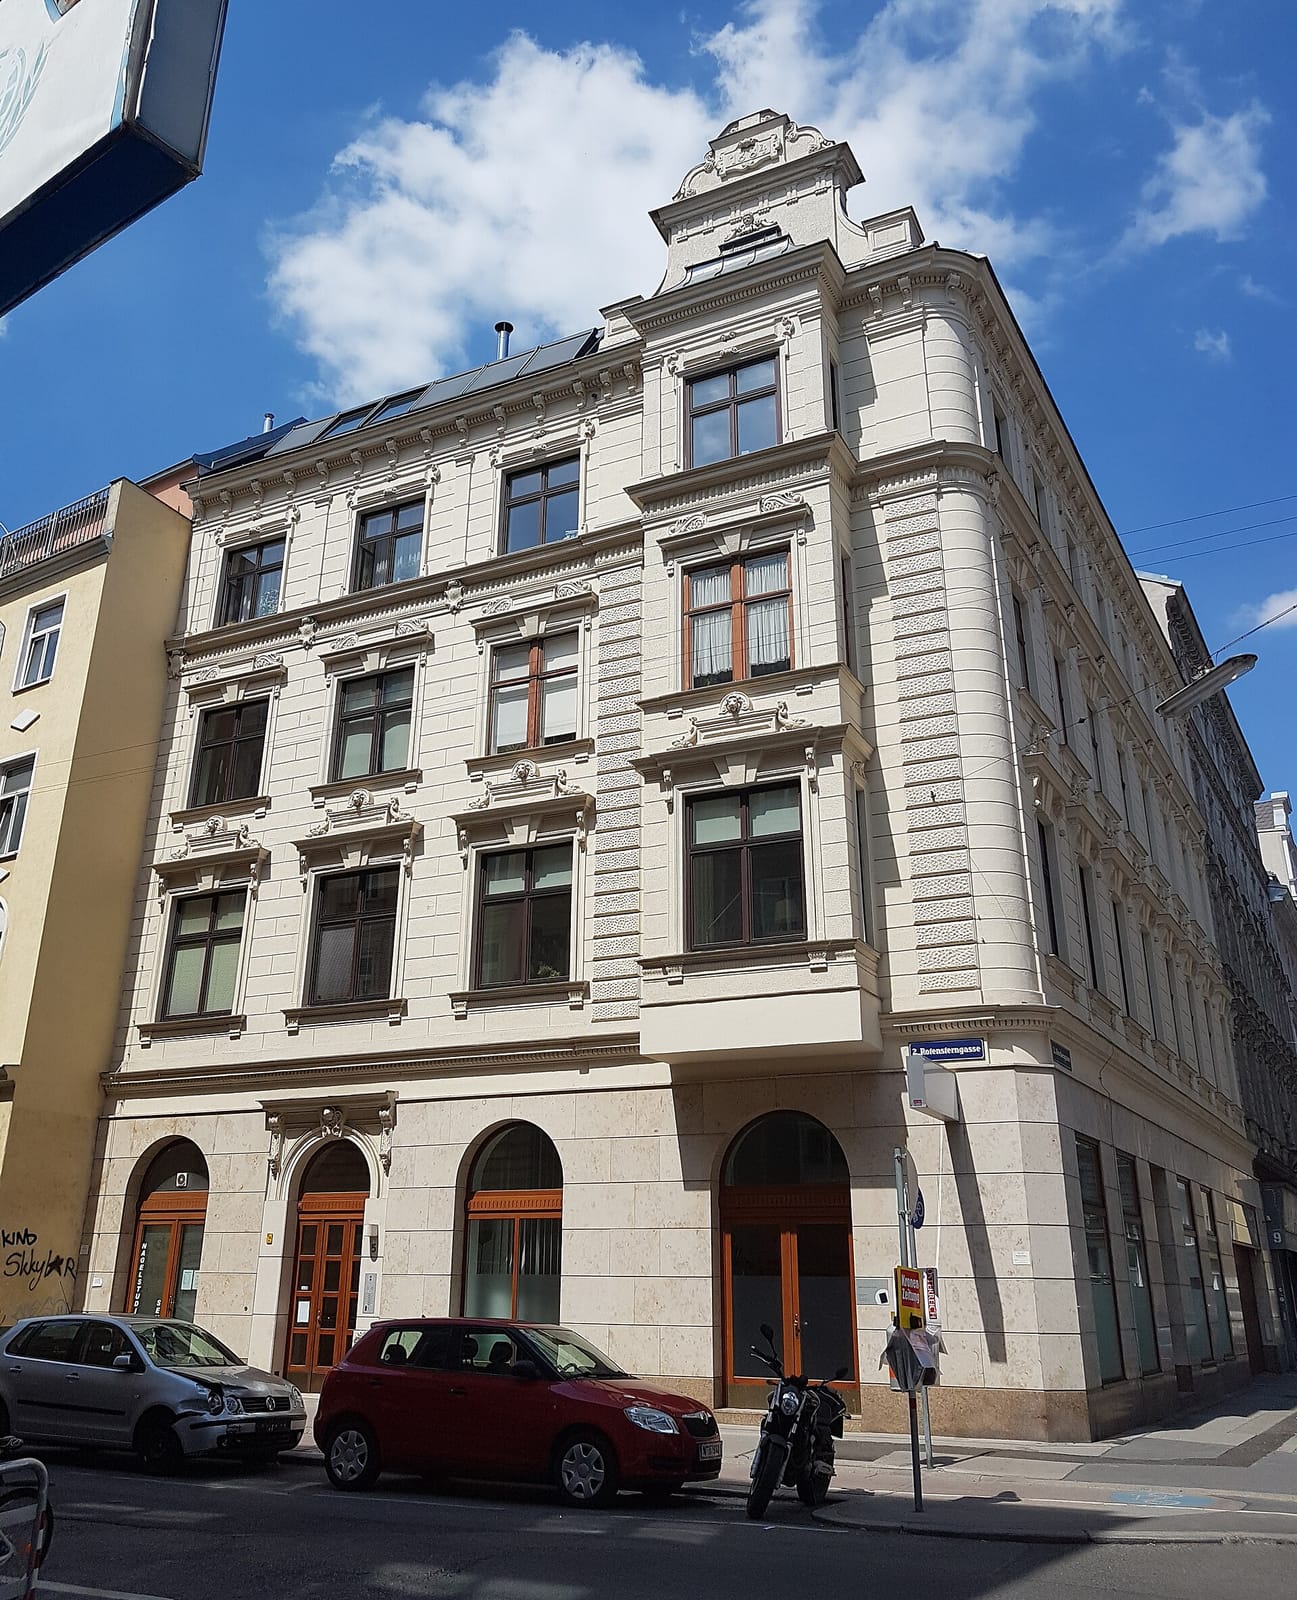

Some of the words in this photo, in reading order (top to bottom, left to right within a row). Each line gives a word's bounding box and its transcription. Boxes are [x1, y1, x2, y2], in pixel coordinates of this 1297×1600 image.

[920, 1046, 981, 1056] Rotensterngasse
[1273, 1232, 1282, 1243] 9
[371, 1243, 377, 1253] 5
[901, 1274, 919, 1289] Kronen
[902, 1287, 920, 1304] Zeitung
